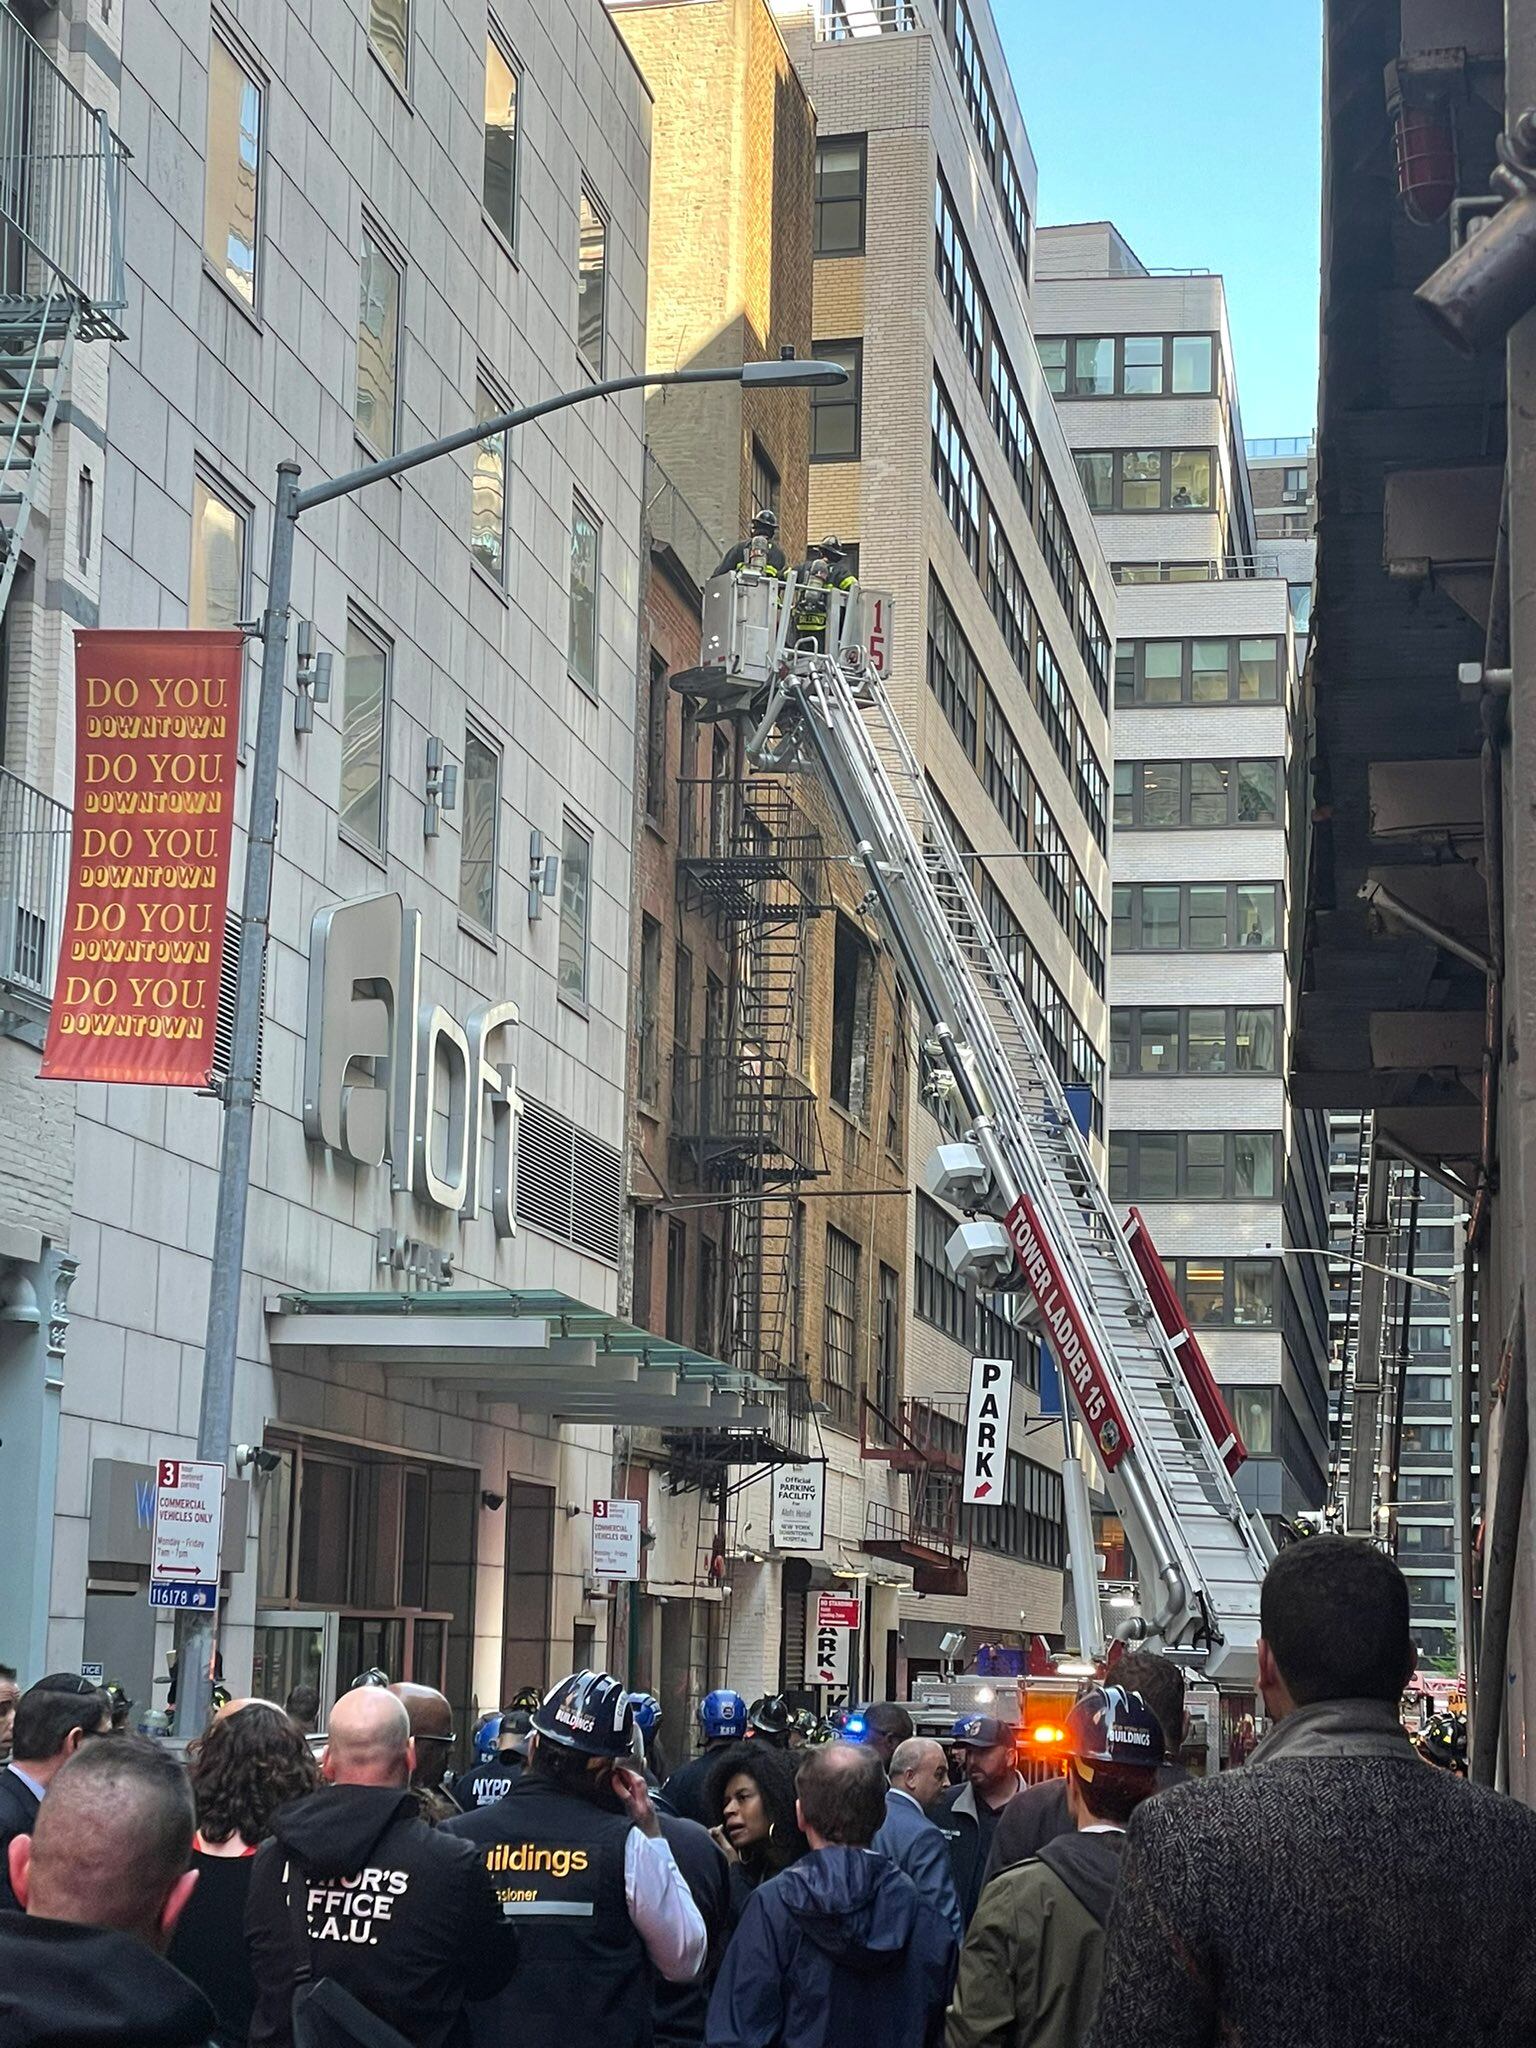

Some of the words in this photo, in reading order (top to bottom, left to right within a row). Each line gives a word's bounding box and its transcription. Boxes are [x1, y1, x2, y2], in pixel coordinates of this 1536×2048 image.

[86, 678, 139, 708] DO
[150, 678, 228, 708] YOU.
[87, 716, 226, 738] DOWNTOWN
[85, 754, 137, 783] DO
[147, 754, 223, 783] YOU.
[84, 791, 221, 813] DOWNTOWN
[82, 828, 132, 858] DO
[144, 828, 218, 858] YOU.
[79, 865, 216, 888] DOWNTOWN
[74, 903, 126, 932] DO
[138, 903, 212, 933] YOU.
[71, 939, 210, 963] DOWNTOWN
[65, 977, 117, 1006] DO
[129, 977, 205, 1009] YOU.
[60, 1013, 203, 1039] DOWNTOWN
[1011, 1207, 1052, 1298] TOWER
[1049, 1297, 1092, 1394] LADDER
[1084, 1385, 1106, 1421] 15
[975, 1364, 1001, 1478] PARK
[163, 1462, 174, 1486] 3
[778, 1492, 816, 1500] FACILITY
[780, 1483, 815, 1492] PARKING
[160, 1498, 206, 1510] COMMERCIAL
[596, 1501, 604, 1516] 3
[159, 1510, 193, 1522] VEHICLES
[195, 1513, 213, 1523] ONLY
[595, 1524, 627, 1532] COMMERCIAL
[157, 1536, 180, 1550] Monday
[186, 1538, 205, 1549] Friday
[152, 1588, 187, 1605] 116178
[818, 1627, 838, 1667] ARK
[82, 1665, 101, 1675] TICE
[555, 1709, 595, 1733] BUILDINGS
[1109, 1730, 1150, 1746] BUILDINGS
[472, 1778, 512, 1796] NYPD
[286, 1889, 394, 1920] FFICE
